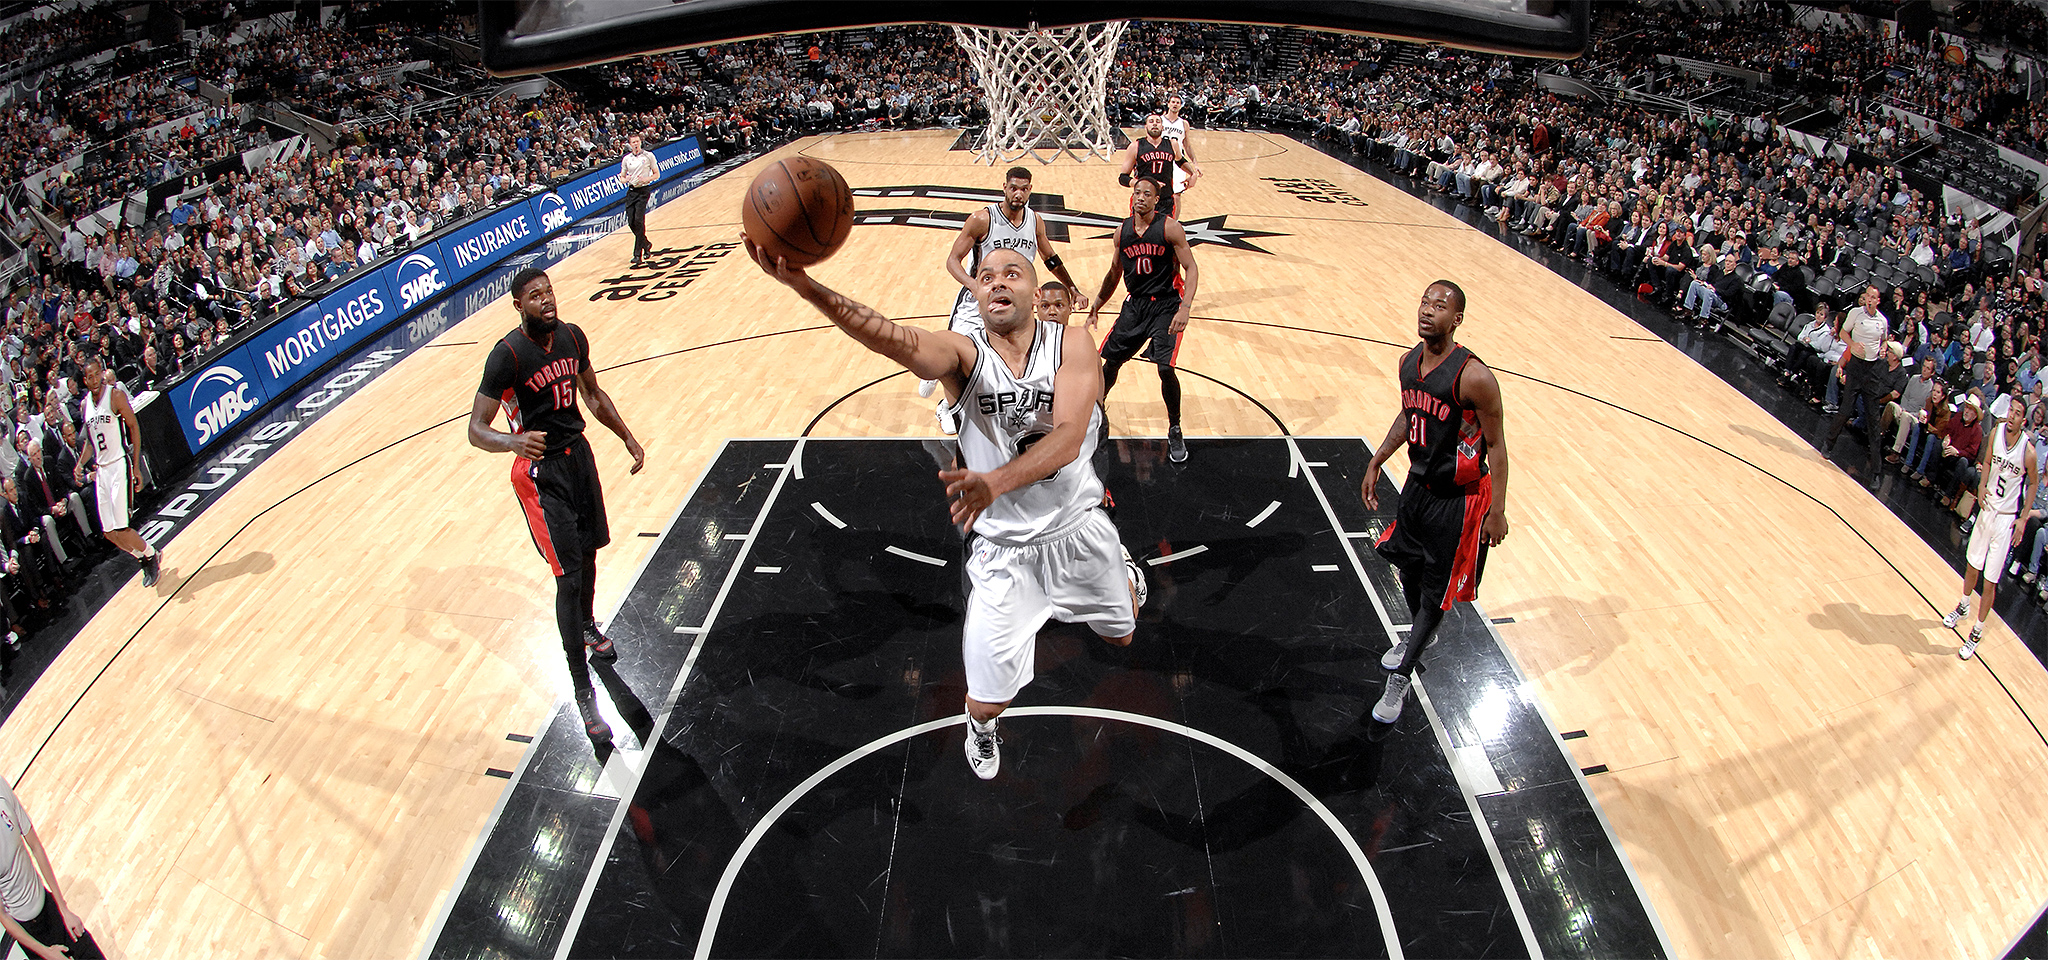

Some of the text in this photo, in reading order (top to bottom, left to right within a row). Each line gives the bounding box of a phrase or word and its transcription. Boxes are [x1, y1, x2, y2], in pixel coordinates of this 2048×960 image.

[657, 147, 701, 172] www.swbc.com
[1140, 151, 1173, 163] TORONTO
[1151, 160, 1165, 174] 17
[191, 175, 199, 187] 8
[570, 173, 629, 211] INVESTMEN
[541, 206, 572, 234] SWBC
[453, 215, 530, 269] INSURANCE
[993, 237, 1034, 250] SPURS
[1123, 242, 1166, 259] TORONTO
[637, 241, 743, 302] CENTER
[1136, 256, 1153, 275] 10
[399, 268, 444, 310] SWBC
[265, 288, 384, 379] MORTGAGES
[552, 378, 573, 411] 15
[977, 387, 1054, 417] SPUR
[194, 382, 254, 445] SWBC
[96, 432, 107, 451] 2
[1409, 412, 1427, 447] 31
[1995, 475, 2007, 498] 5
